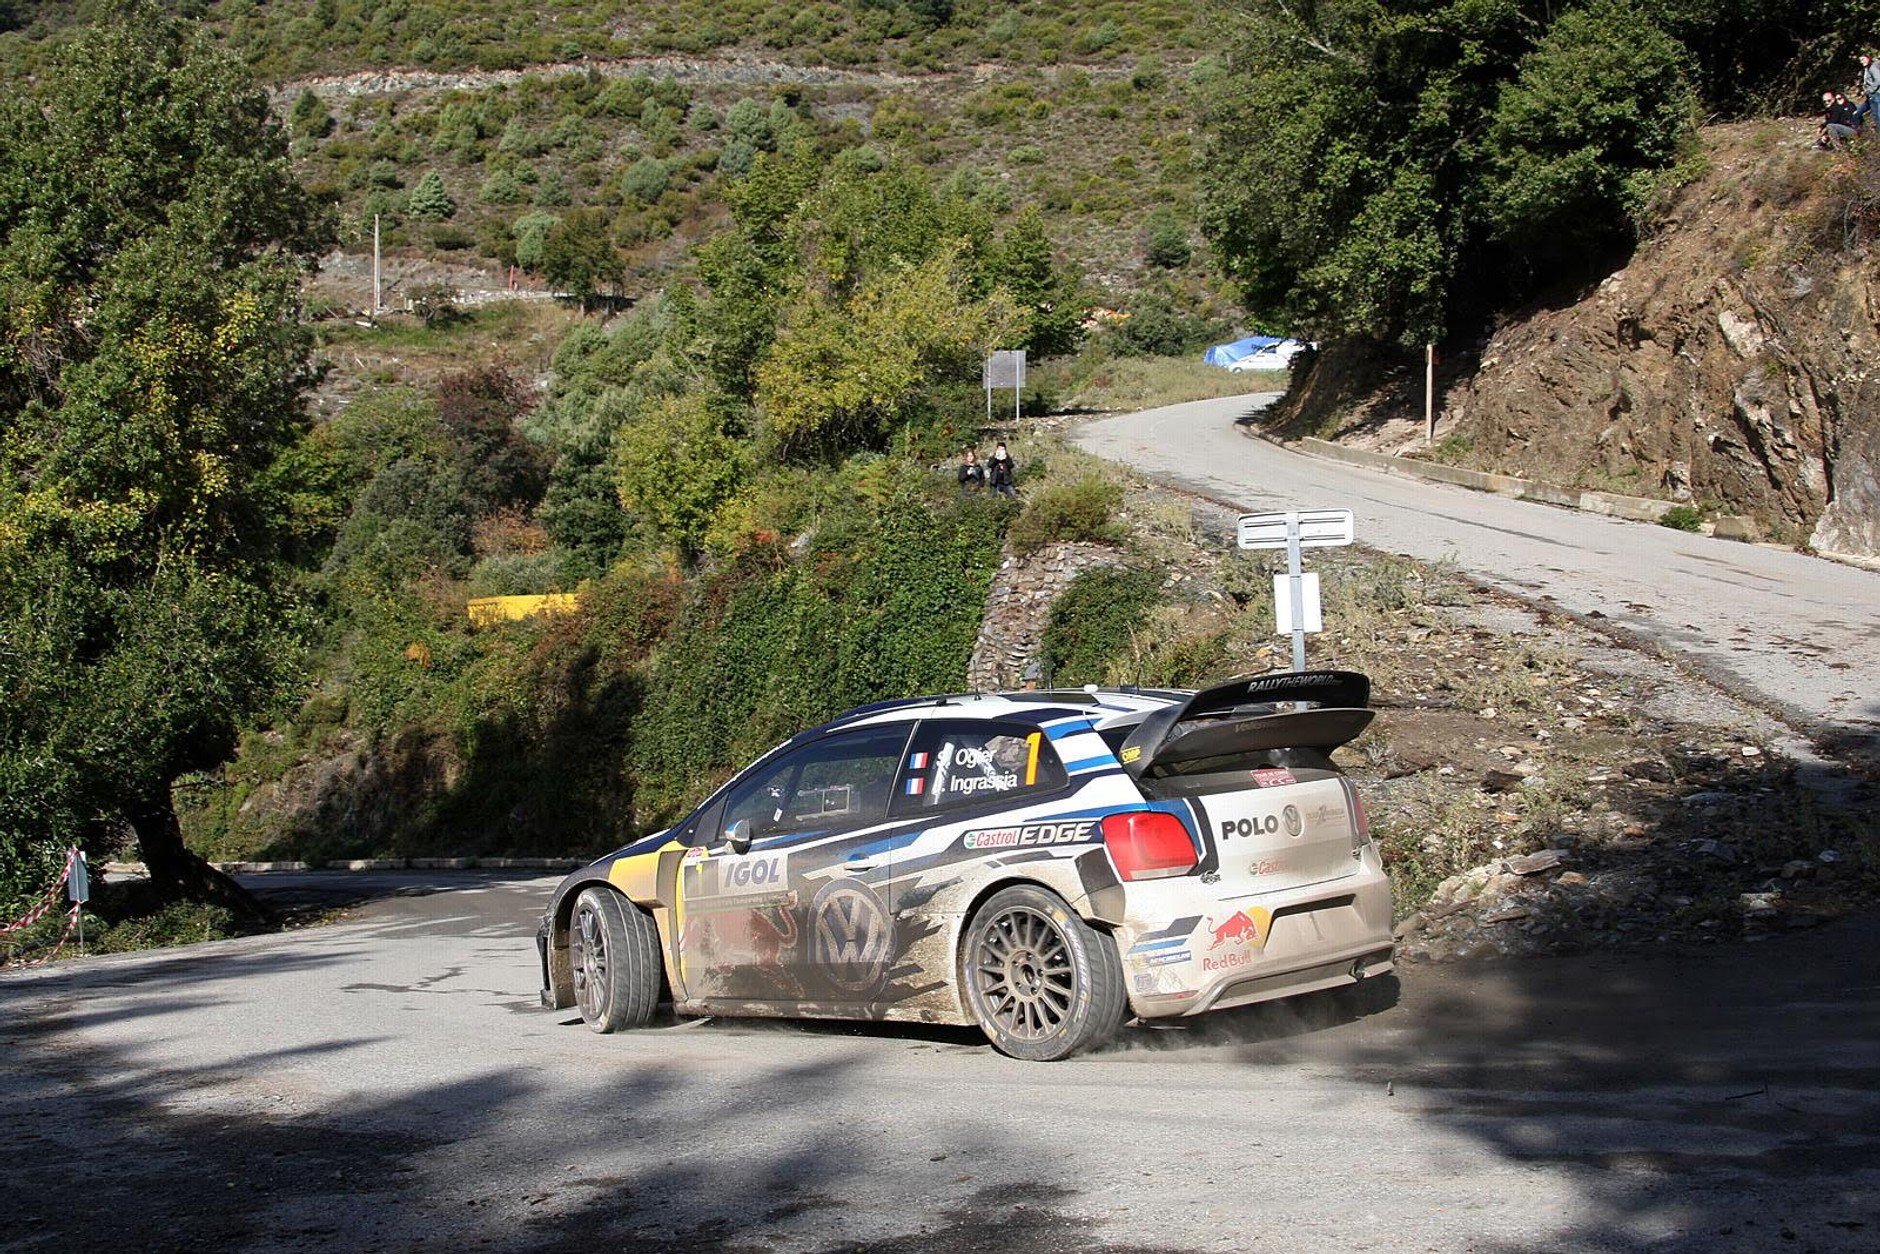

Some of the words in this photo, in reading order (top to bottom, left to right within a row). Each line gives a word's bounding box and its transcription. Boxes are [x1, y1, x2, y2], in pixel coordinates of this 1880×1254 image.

[955, 747, 998, 769] Ogier
[1026, 732, 1042, 785] 1
[950, 771, 1018, 795] Ingrassia
[976, 830, 1017, 847] Castrol
[1019, 821, 1097, 845] EDGE
[1221, 814, 1279, 840] POLO
[724, 858, 781, 888] IGOL
